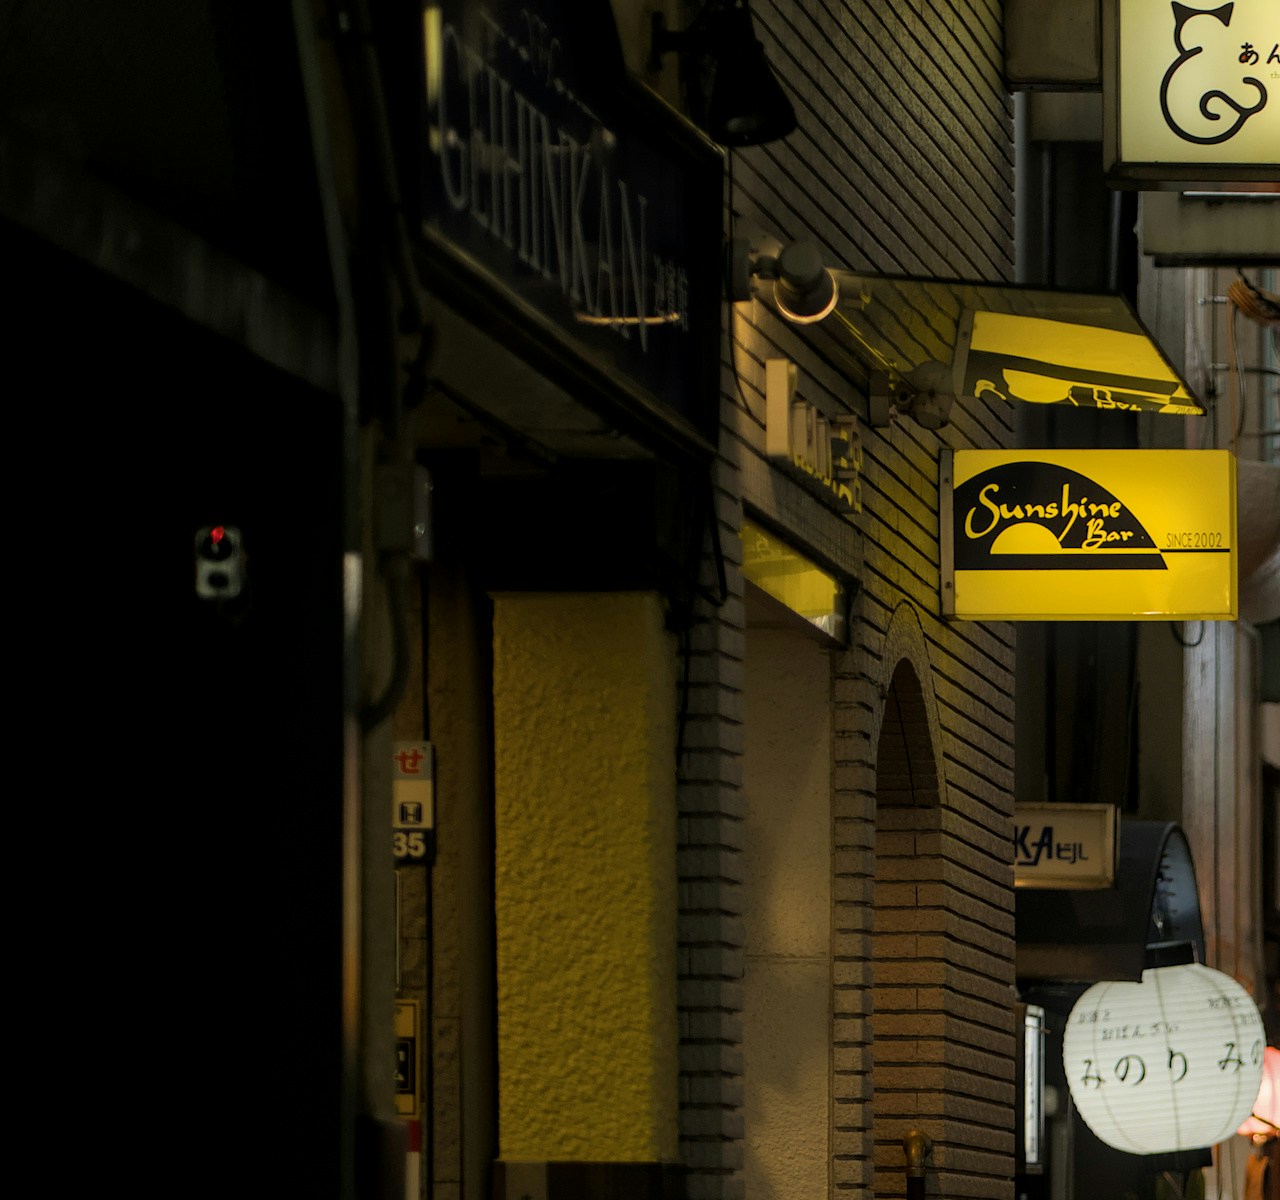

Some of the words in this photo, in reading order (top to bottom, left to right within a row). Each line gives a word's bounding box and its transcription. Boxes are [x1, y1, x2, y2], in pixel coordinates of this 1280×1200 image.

[964, 483, 1123, 542] Sunshine
[1080, 518, 1136, 549] Bar
[1166, 532, 1193, 548] SINCE
[1194, 531, 1223, 548] 2002
[1080, 1047, 1188, 1089] みのり
